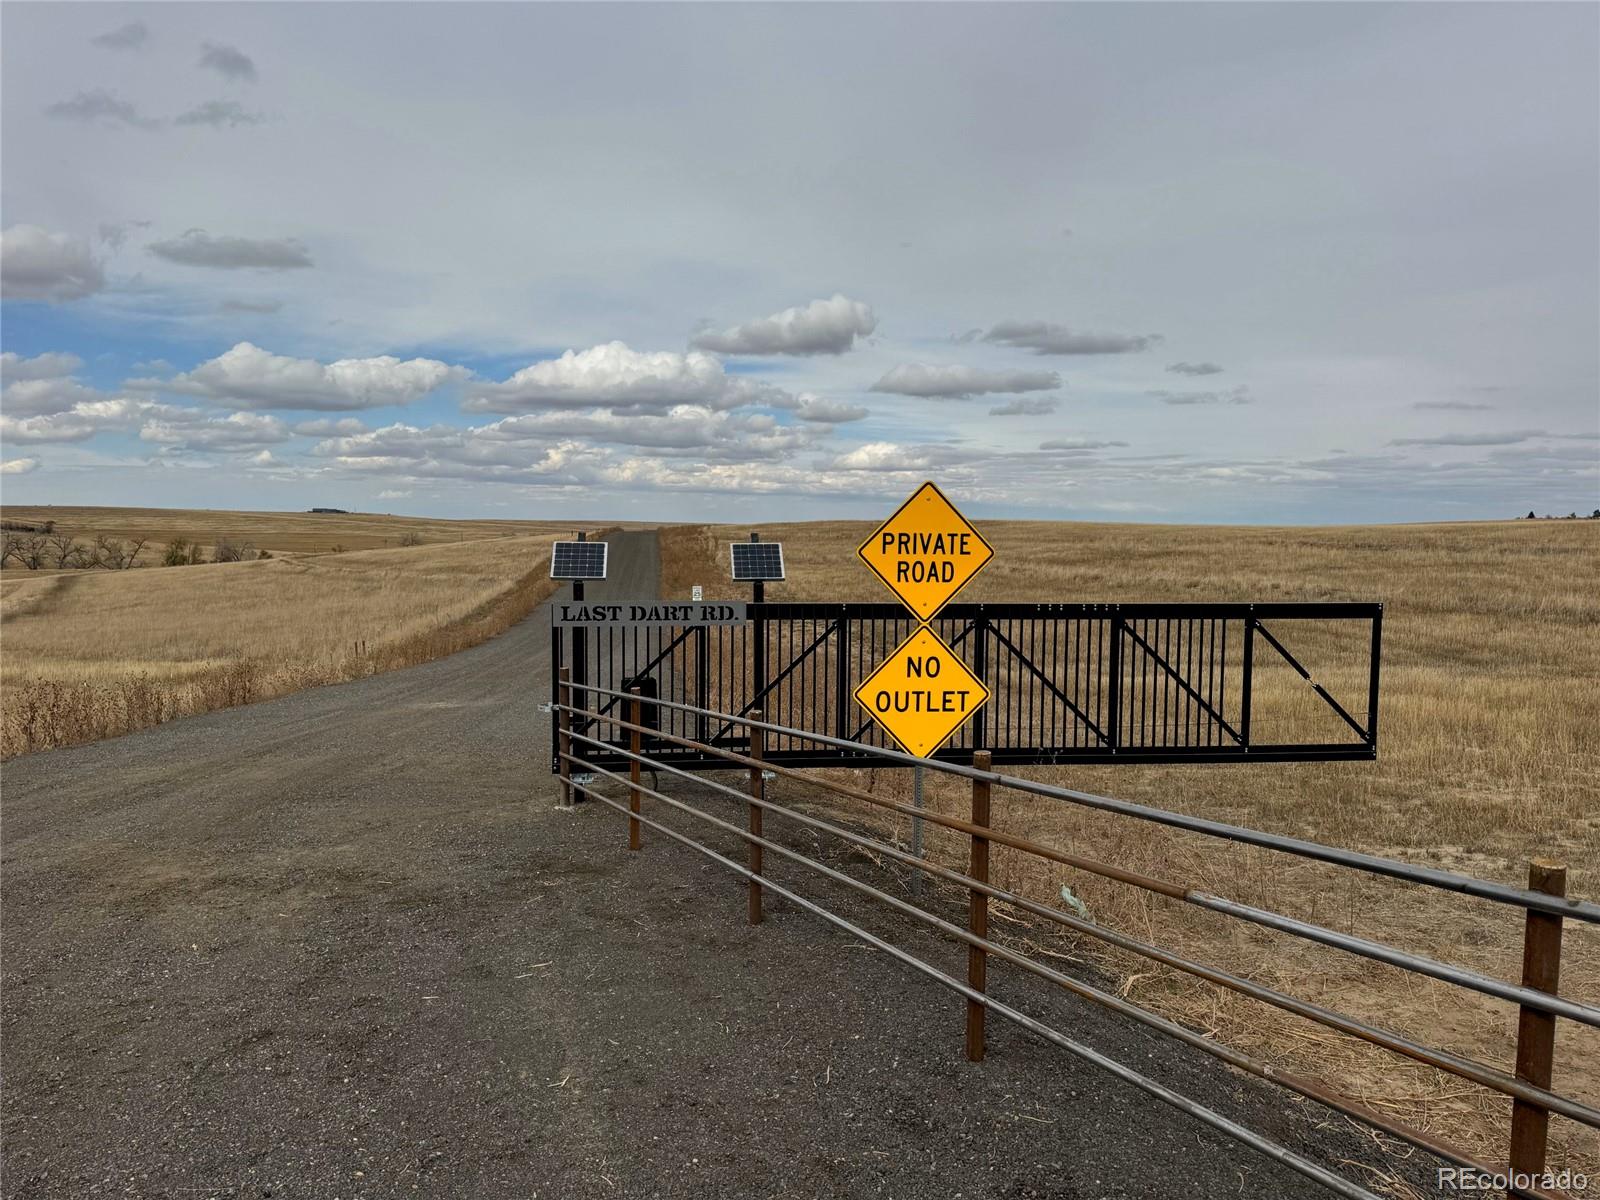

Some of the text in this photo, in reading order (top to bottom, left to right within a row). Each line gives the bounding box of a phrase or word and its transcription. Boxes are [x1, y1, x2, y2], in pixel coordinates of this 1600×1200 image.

[882, 532, 971, 556] PRIVATE
[897, 561, 955, 583] ROAD
[561, 605, 739, 622] LAST DART RD.
[907, 656, 940, 678] NO
[875, 690, 970, 713] OUTLET
